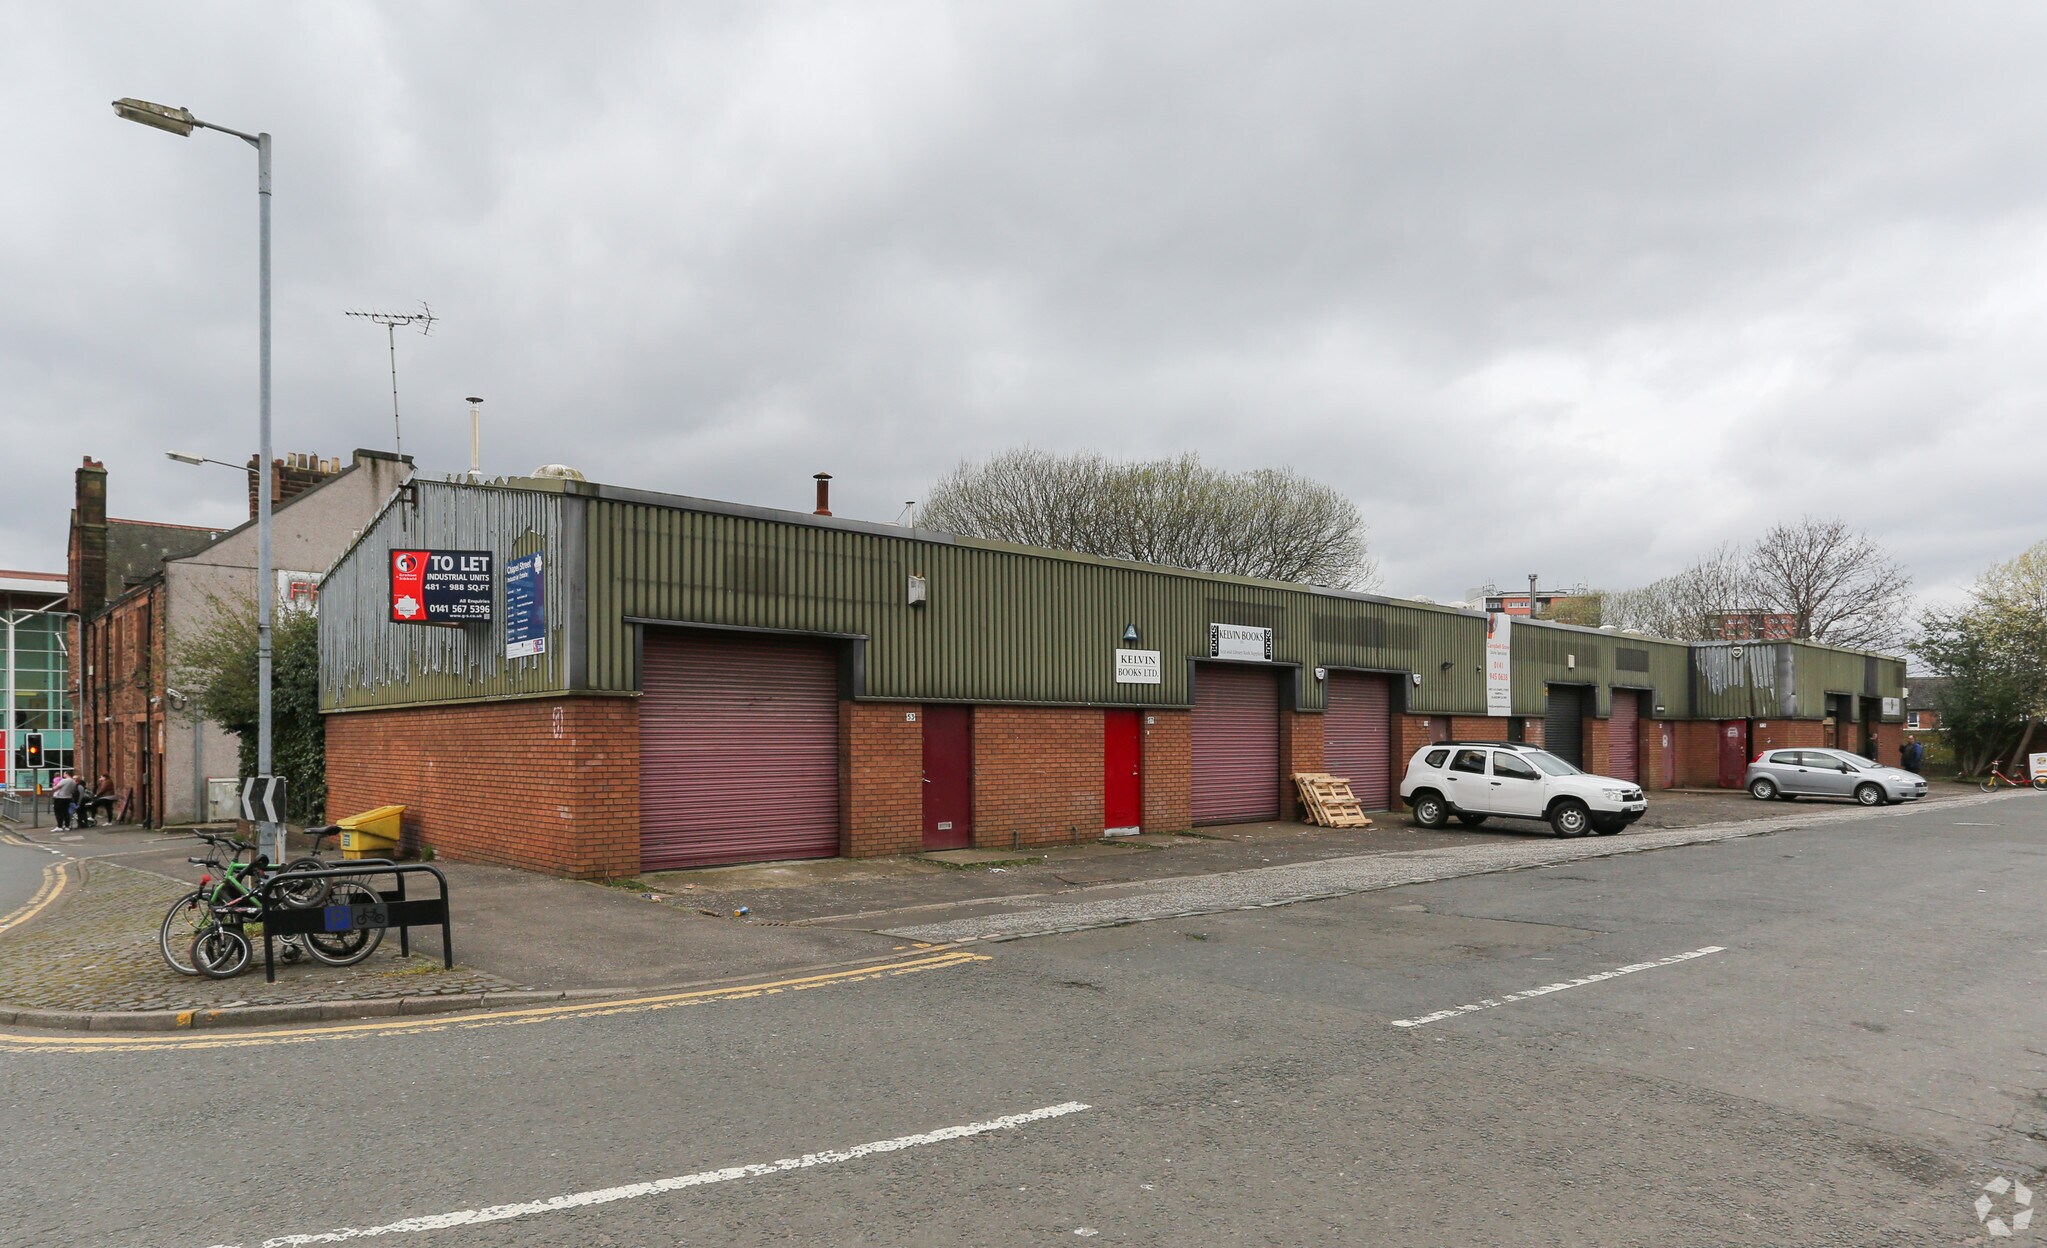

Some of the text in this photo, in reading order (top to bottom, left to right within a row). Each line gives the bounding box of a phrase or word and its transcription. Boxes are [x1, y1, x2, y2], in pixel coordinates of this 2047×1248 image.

[431, 555, 489, 572] TO LET
[507, 559, 531, 574] Chapel Street
[427, 573, 467, 581] INDUSTRIAL
[467, 584, 489, 592] SQ.FT
[429, 604, 490, 613] 0141 567 5396
[1219, 629, 1263, 641] KELVIN BOOKS
[1121, 655, 1155, 664] KELVIN
[1118, 668, 1159, 677] BOOKS LTD.
